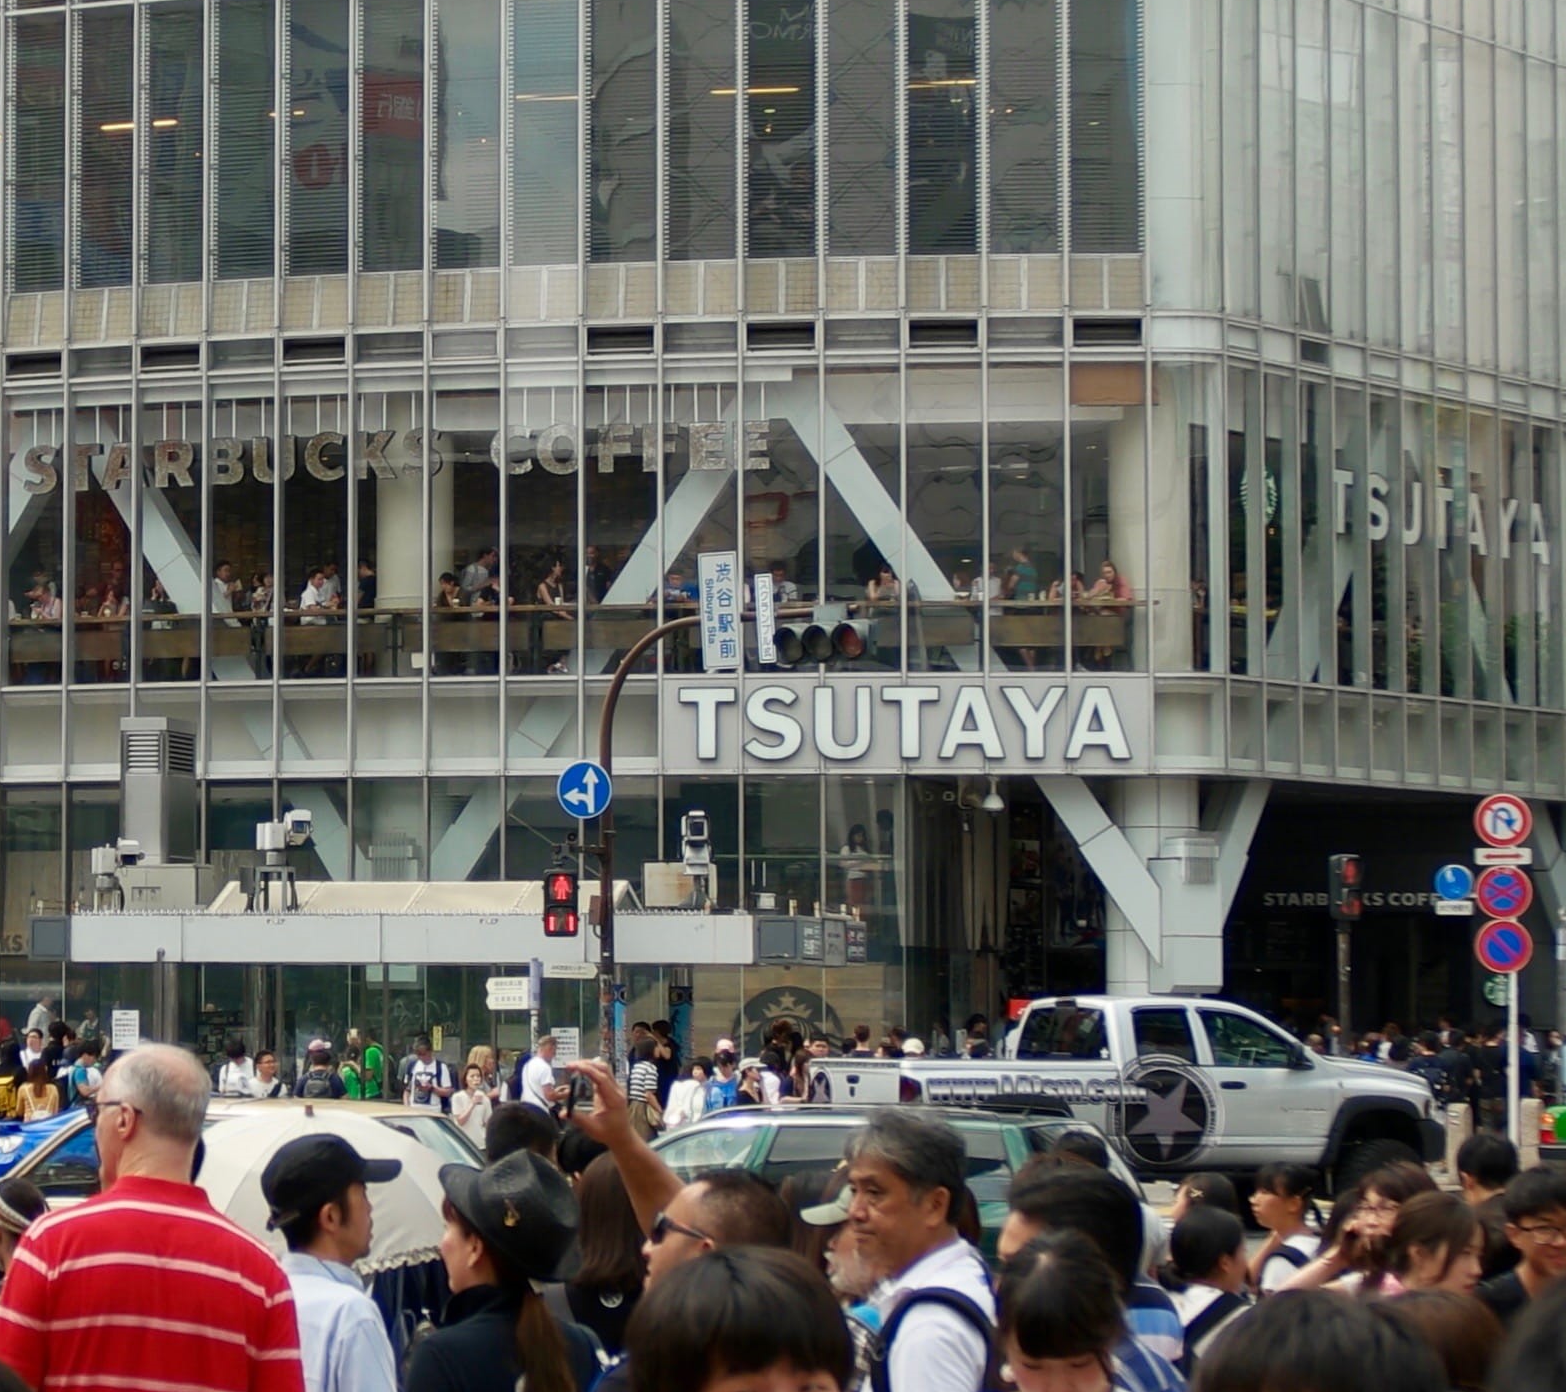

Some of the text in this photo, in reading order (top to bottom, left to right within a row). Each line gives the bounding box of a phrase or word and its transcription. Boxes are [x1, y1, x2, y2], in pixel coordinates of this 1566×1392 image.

[23, 428, 446, 495] STARBUCKS
[489, 420, 771, 476] COFFEE
[1333, 469, 1551, 567] TSUTAYA
[716, 561, 737, 659] 渋谷駅前
[678, 684, 1133, 761] TSUTAYA
[1263, 892, 1384, 907] STARBKS
